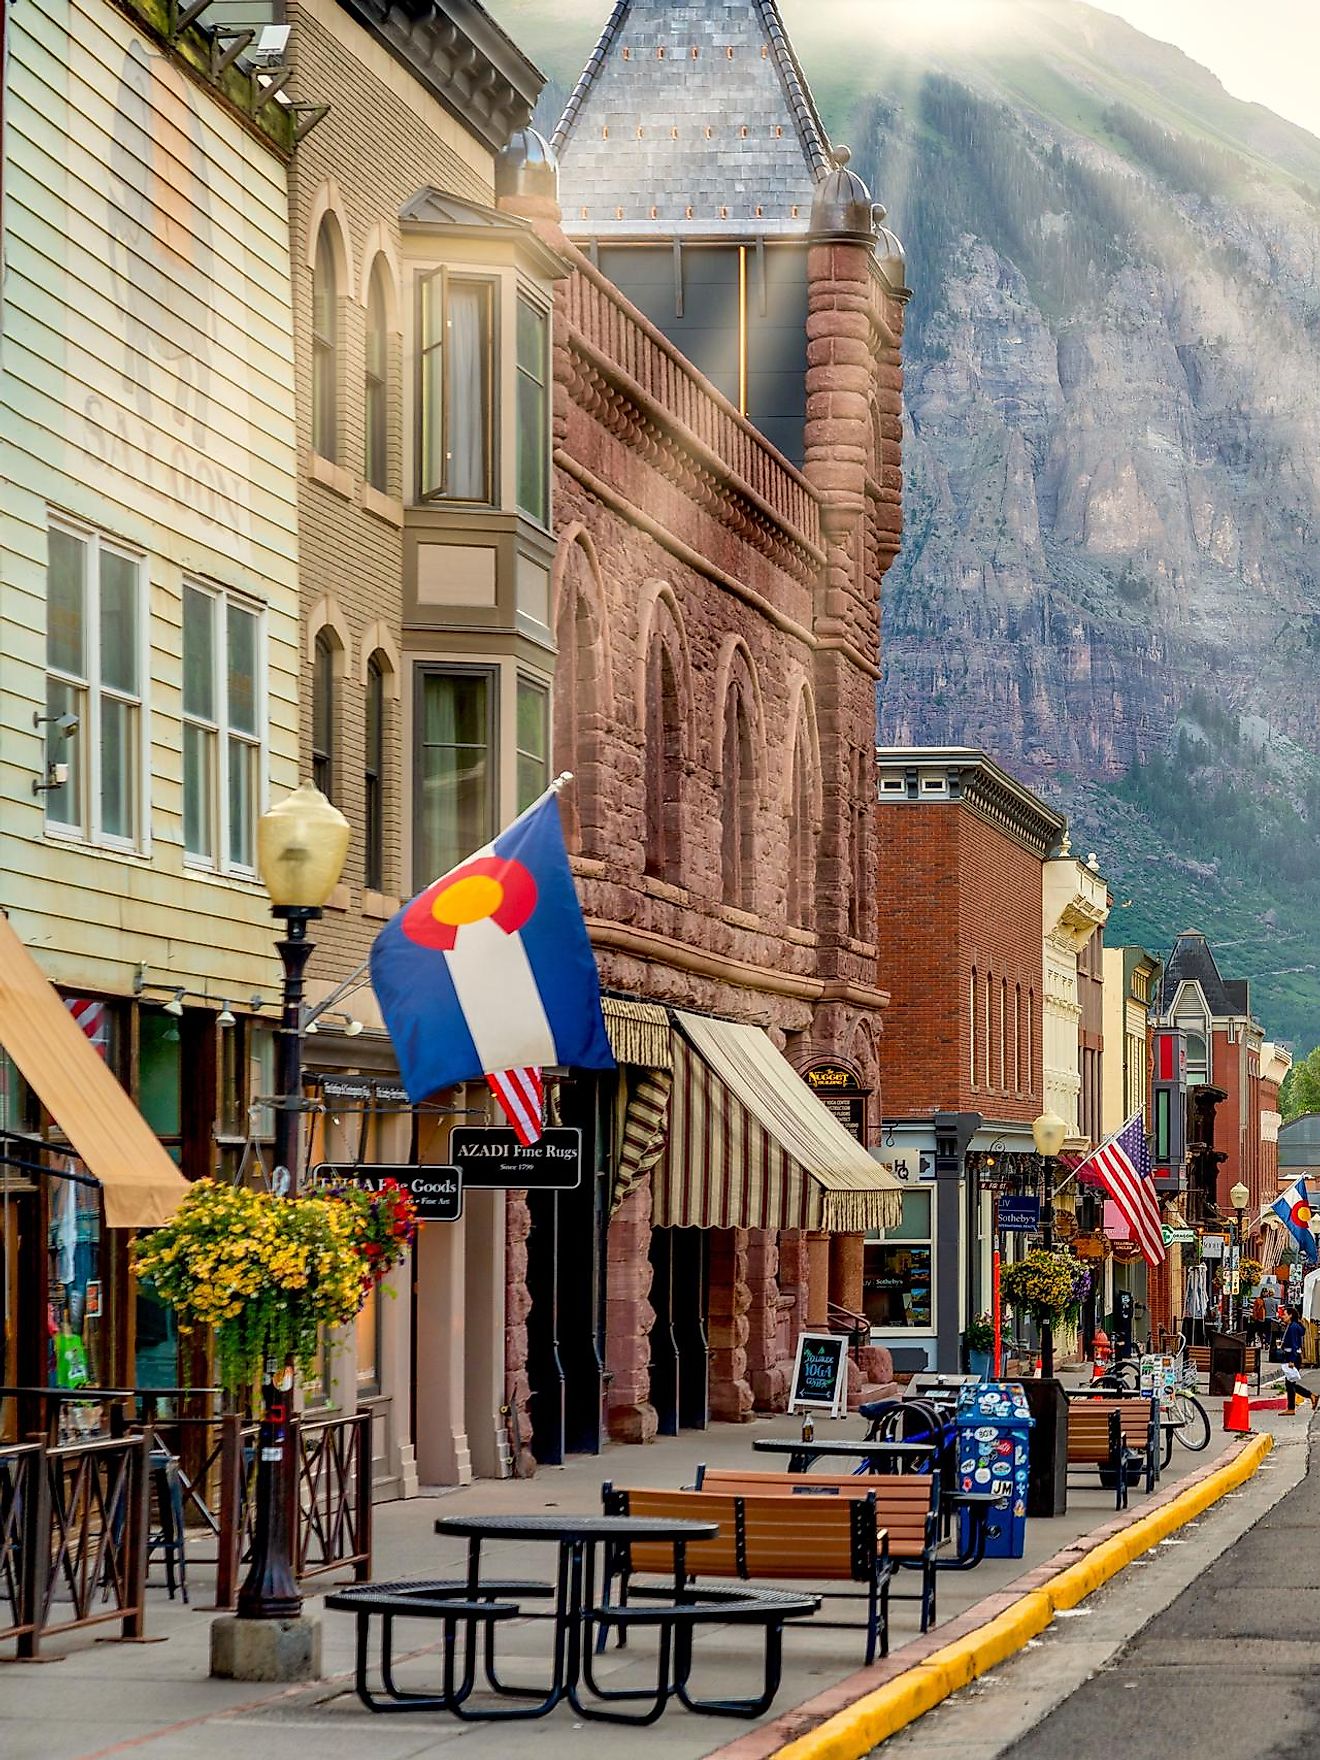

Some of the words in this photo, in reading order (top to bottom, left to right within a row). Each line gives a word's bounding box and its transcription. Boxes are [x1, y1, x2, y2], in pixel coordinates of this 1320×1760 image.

[458, 1144, 508, 1157] AZADI
[514, 1145, 542, 1157] Fine
[546, 1145, 577, 1160] Rugs
[378, 1178, 408, 1191] Fe
[412, 1178, 457, 1193] Goods
[998, 1214, 1035, 1224] Sotheby's
[876, 1278, 903, 1286] Sotheby's
[805, 1362, 832, 1378] YOGA
